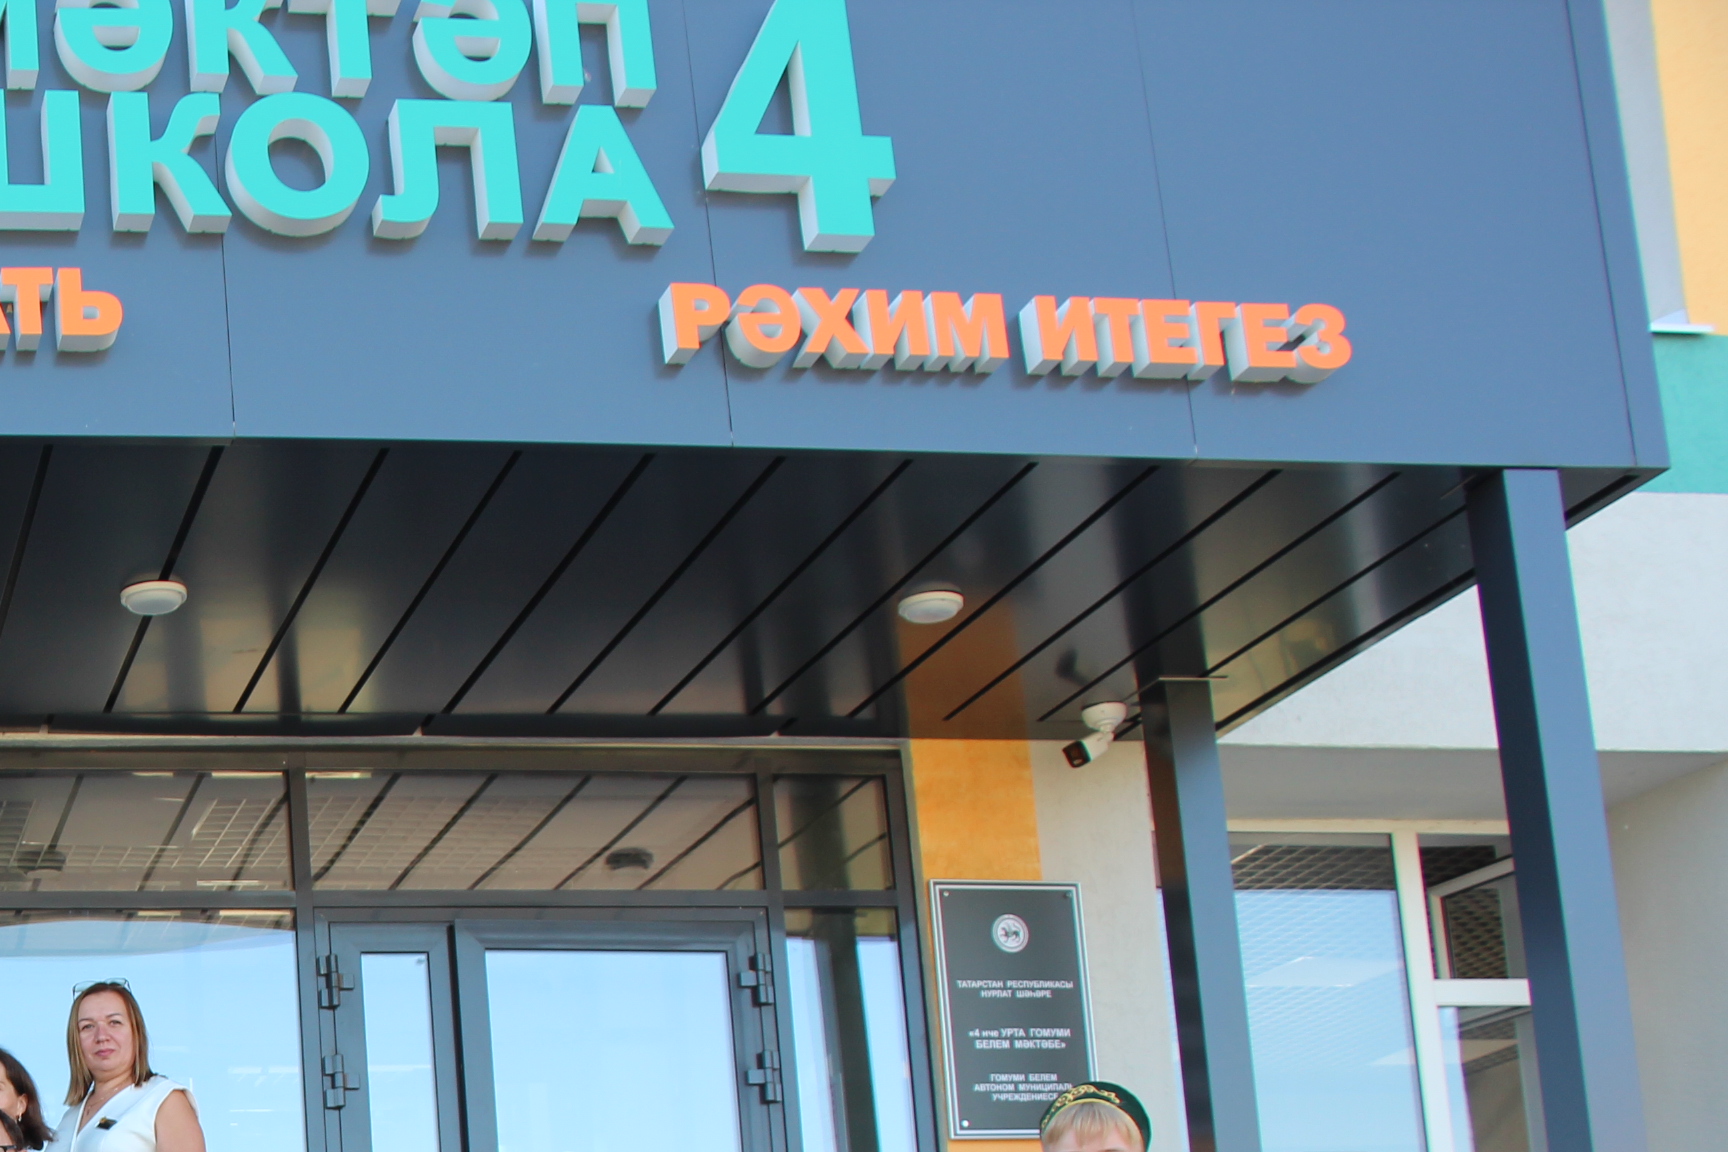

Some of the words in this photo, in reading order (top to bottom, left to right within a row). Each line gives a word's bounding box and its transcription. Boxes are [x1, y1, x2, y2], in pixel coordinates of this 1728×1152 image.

[702, 0, 898, 250] 4
[662, 284, 1010, 372] РӘХИМ
[1020, 296, 1353, 380] ИТЕГЕЗ
[957, 980, 1004, 988] ТАТАРСТАН
[1007, 980, 1074, 988] РЕСПУБЛИКАСЫ
[980, 990, 1012, 998] НУРЛАТ
[1000, 1028, 1025, 1037] УРТА
[1030, 1028, 1071, 1037] ГОМУМИ
[975, 1040, 1010, 1049] БЕЛЕМ
[990, 1073, 1025, 1081] ГОМУМИ
[1028, 1073, 1057, 1081] БЕЛЕМ
[974, 1083, 1015, 1091] АВТОНОМ
